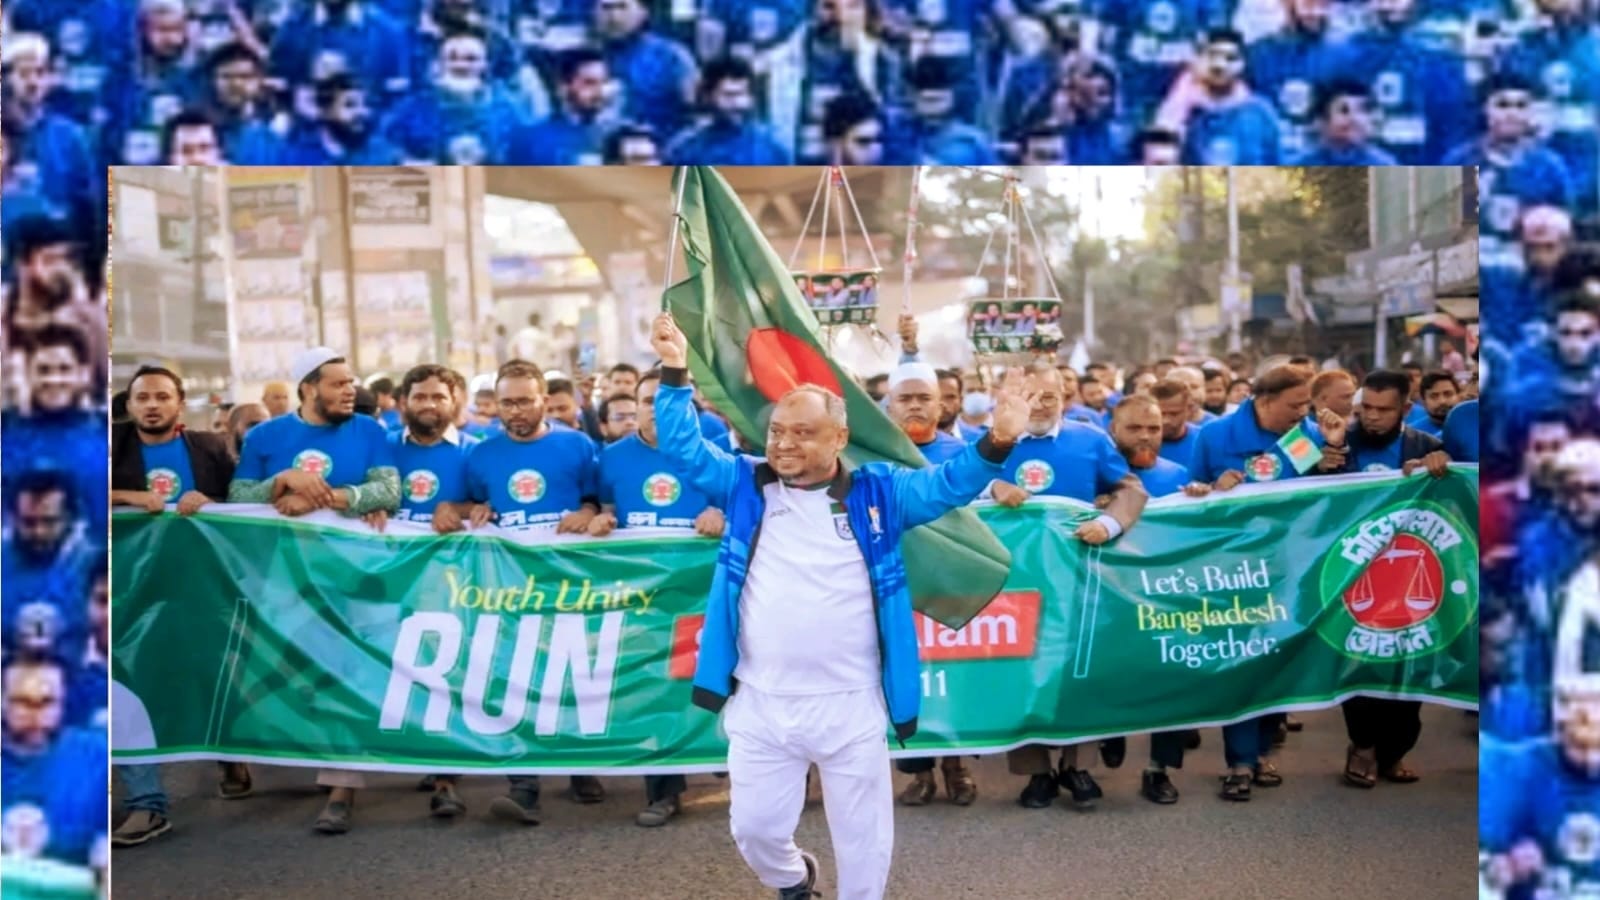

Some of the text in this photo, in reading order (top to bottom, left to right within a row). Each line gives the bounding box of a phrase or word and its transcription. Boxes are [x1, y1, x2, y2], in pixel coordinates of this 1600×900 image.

[446, 570, 658, 615] Youth Unity
[1140, 559, 1270, 596] Let's Build
[918, 614, 1018, 647] lam
[1137, 592, 1288, 635] Bangladesh
[1152, 628, 1280, 669] Together.
[378, 611, 625, 736] RUN
